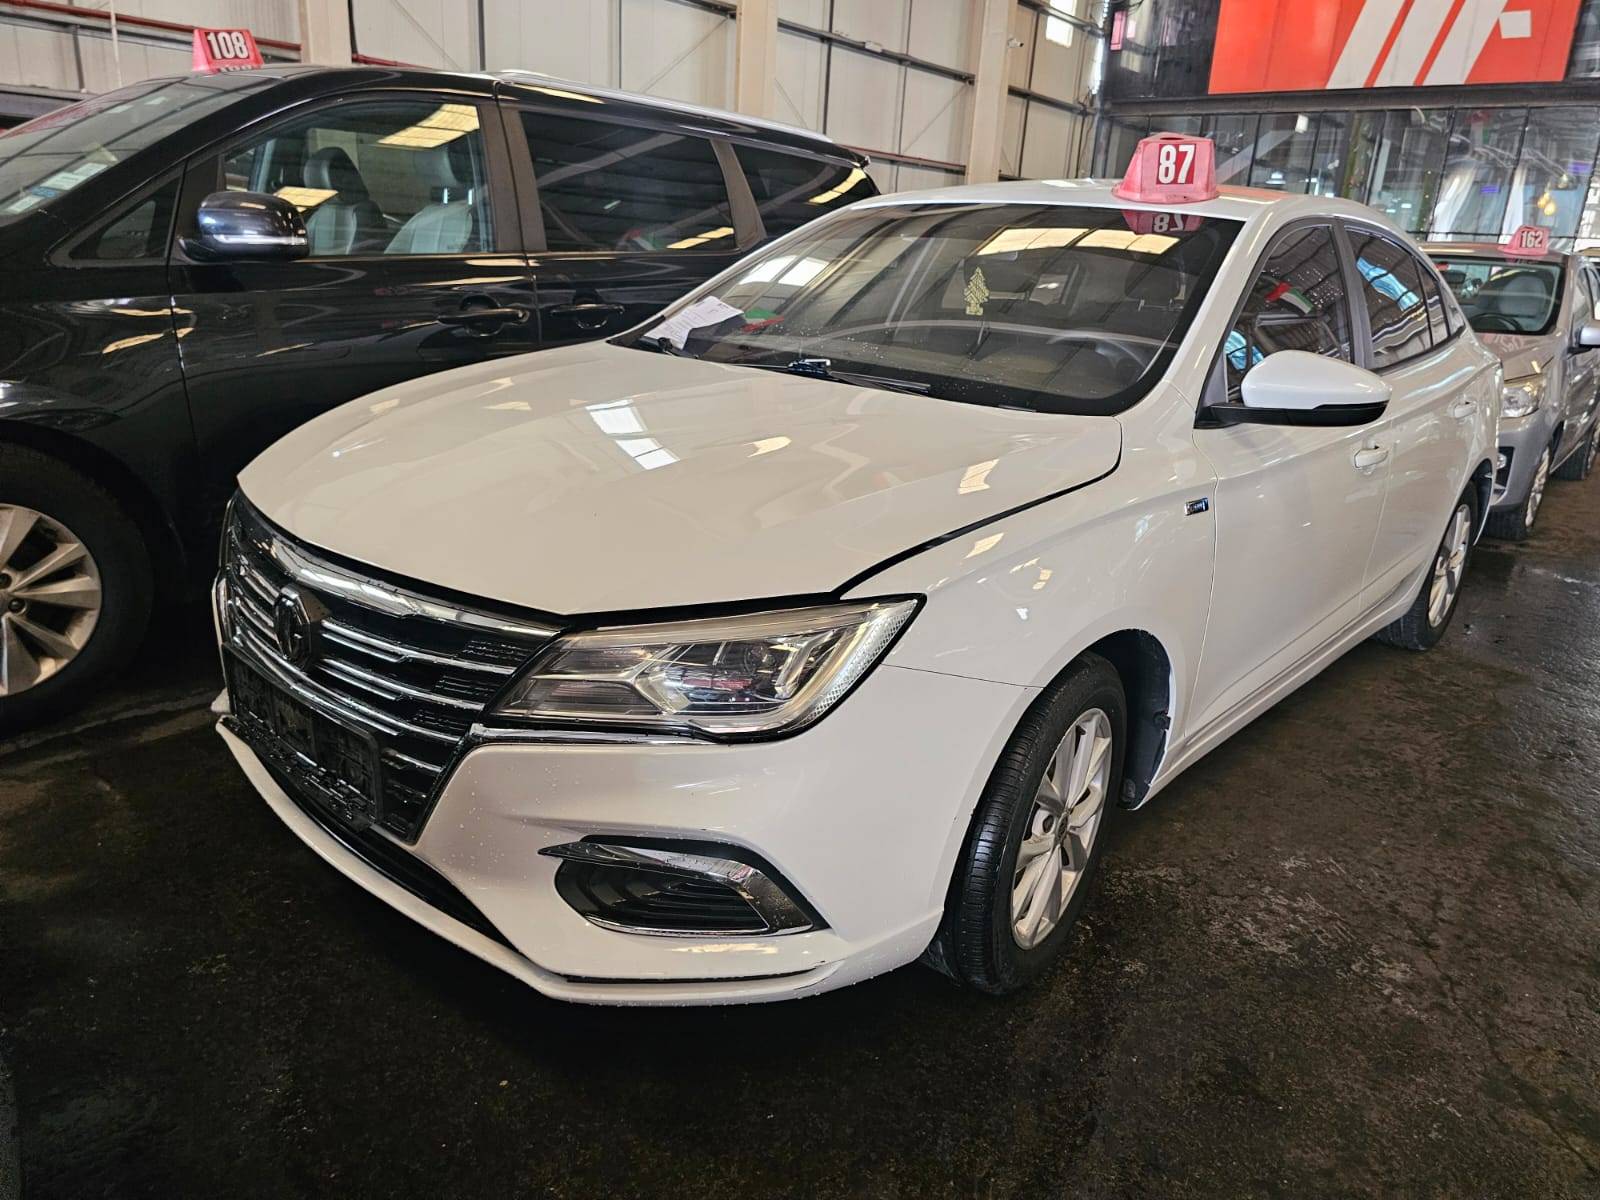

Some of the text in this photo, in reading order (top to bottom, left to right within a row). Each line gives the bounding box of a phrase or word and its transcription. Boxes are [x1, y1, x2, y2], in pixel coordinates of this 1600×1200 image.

[207, 31, 249, 60] 108
[1158, 144, 1195, 184] 87
[1521, 230, 1543, 248] 162
